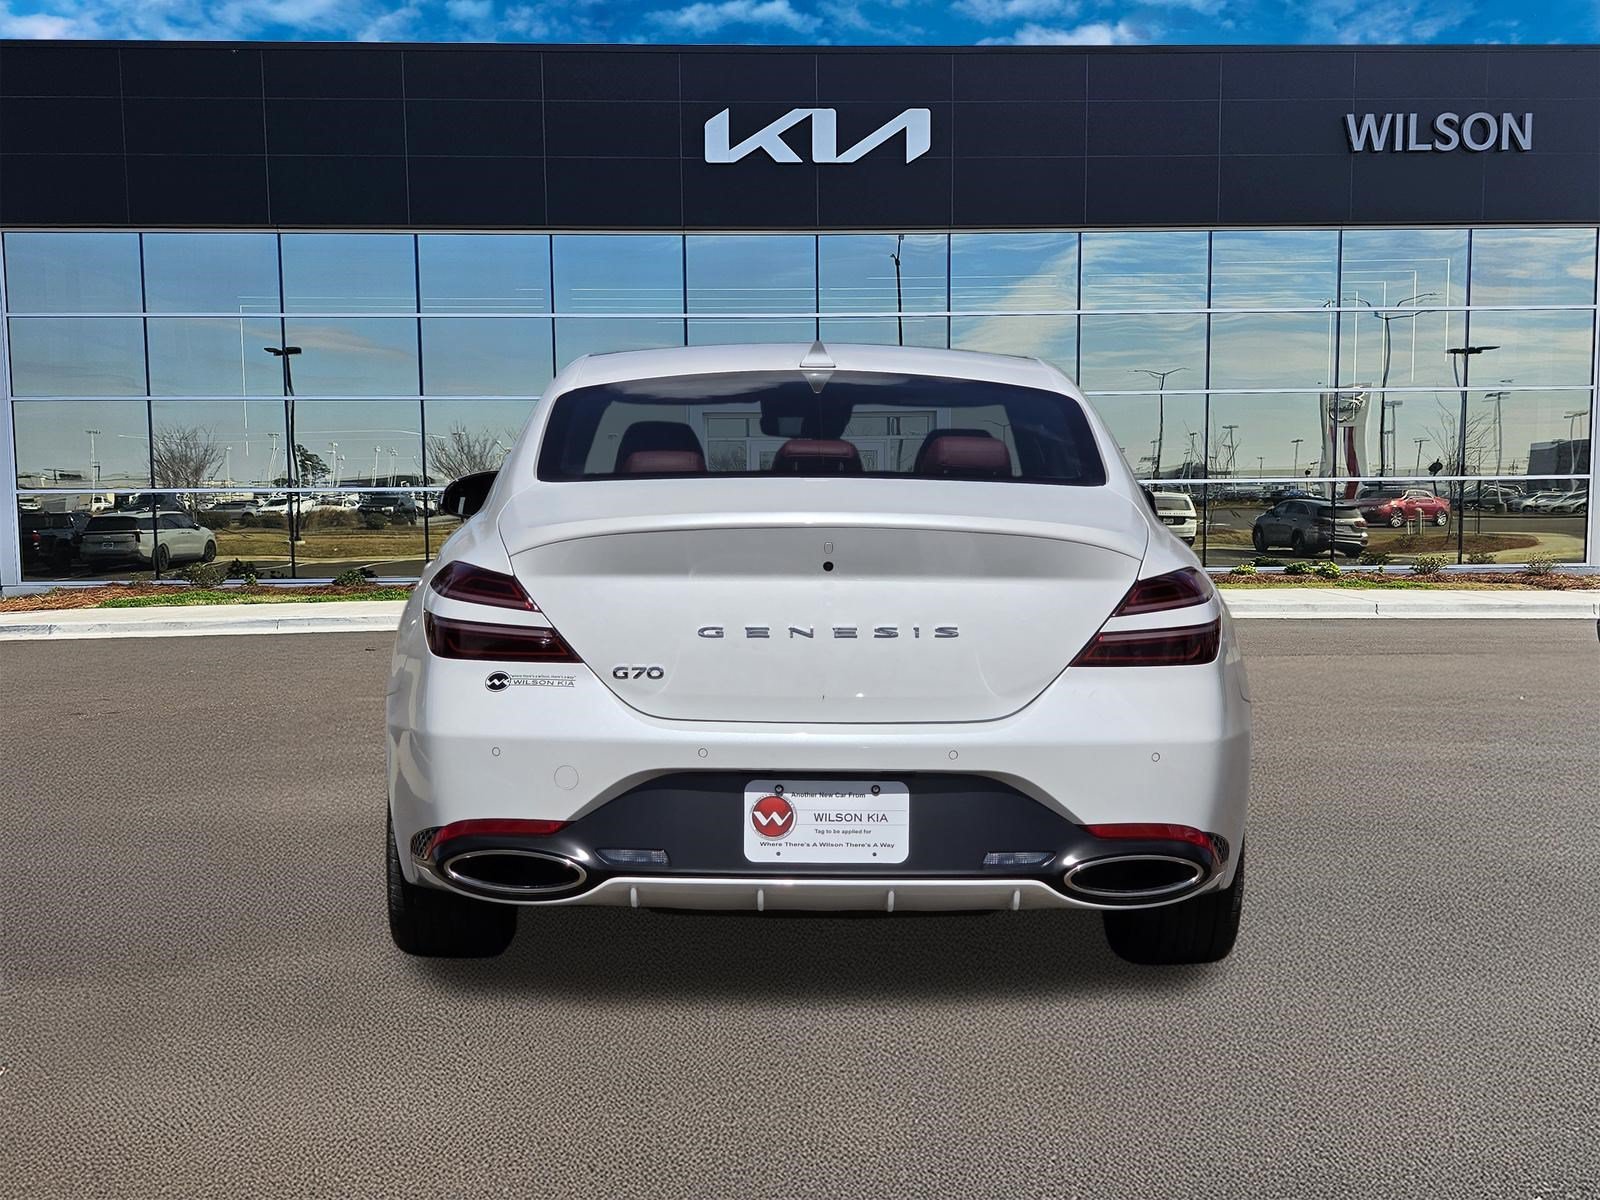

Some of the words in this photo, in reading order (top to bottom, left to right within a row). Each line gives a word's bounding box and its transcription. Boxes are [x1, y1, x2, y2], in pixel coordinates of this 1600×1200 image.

[705, 107, 931, 164] KIA
[1345, 112, 1534, 152] WILSON
[697, 625, 960, 639] GENESIS
[612, 666, 665, 680] G70
[814, 813, 863, 822] WILSON
[867, 814, 888, 822] KIA
